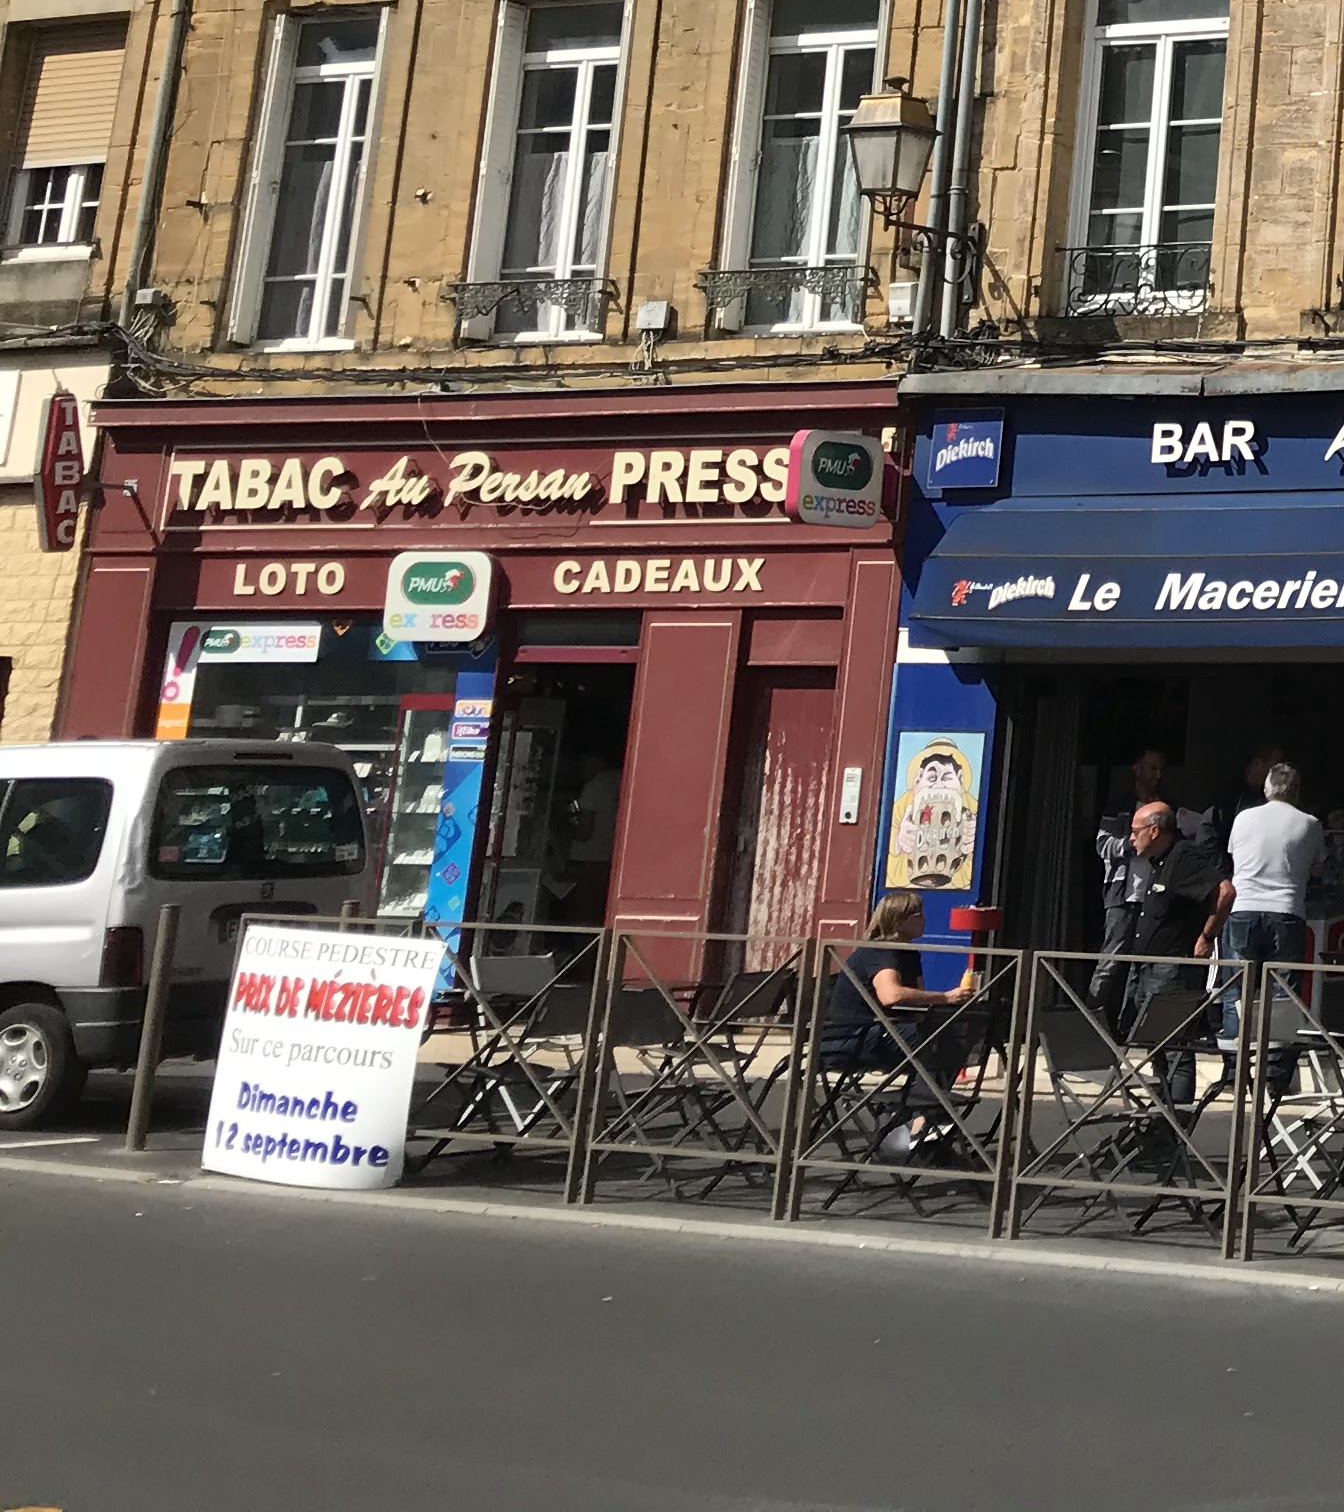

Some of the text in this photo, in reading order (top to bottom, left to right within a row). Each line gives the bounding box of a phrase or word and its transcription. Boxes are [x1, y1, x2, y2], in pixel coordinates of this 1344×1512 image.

[934, 436, 995, 473] Diekirch
[1151, 420, 1255, 464] BAR
[54, 401, 82, 544] TABAC
[171, 456, 345, 511] TABAC
[360, 454, 429, 510] Au
[444, 450, 592, 506] Persan
[817, 457, 846, 476] PMU
[802, 494, 876, 518] express
[233, 562, 345, 596] LOTO
[407, 576, 442, 594] PMU
[553, 557, 764, 594] CADEAUX
[987, 575, 1056, 611] Diekirch
[1067, 573, 1121, 612] Le
[389, 613, 480, 629] exress
[240, 633, 317, 654] express
[245, 936, 437, 970] COURSE PEDESTRE
[233, 968, 426, 1029] PRIX DE MÉZIÈRES
[230, 1028, 394, 1069] Sur ce parcours
[237, 1081, 358, 1123] Dimanche
[215, 1120, 389, 1168] 12 septembre
